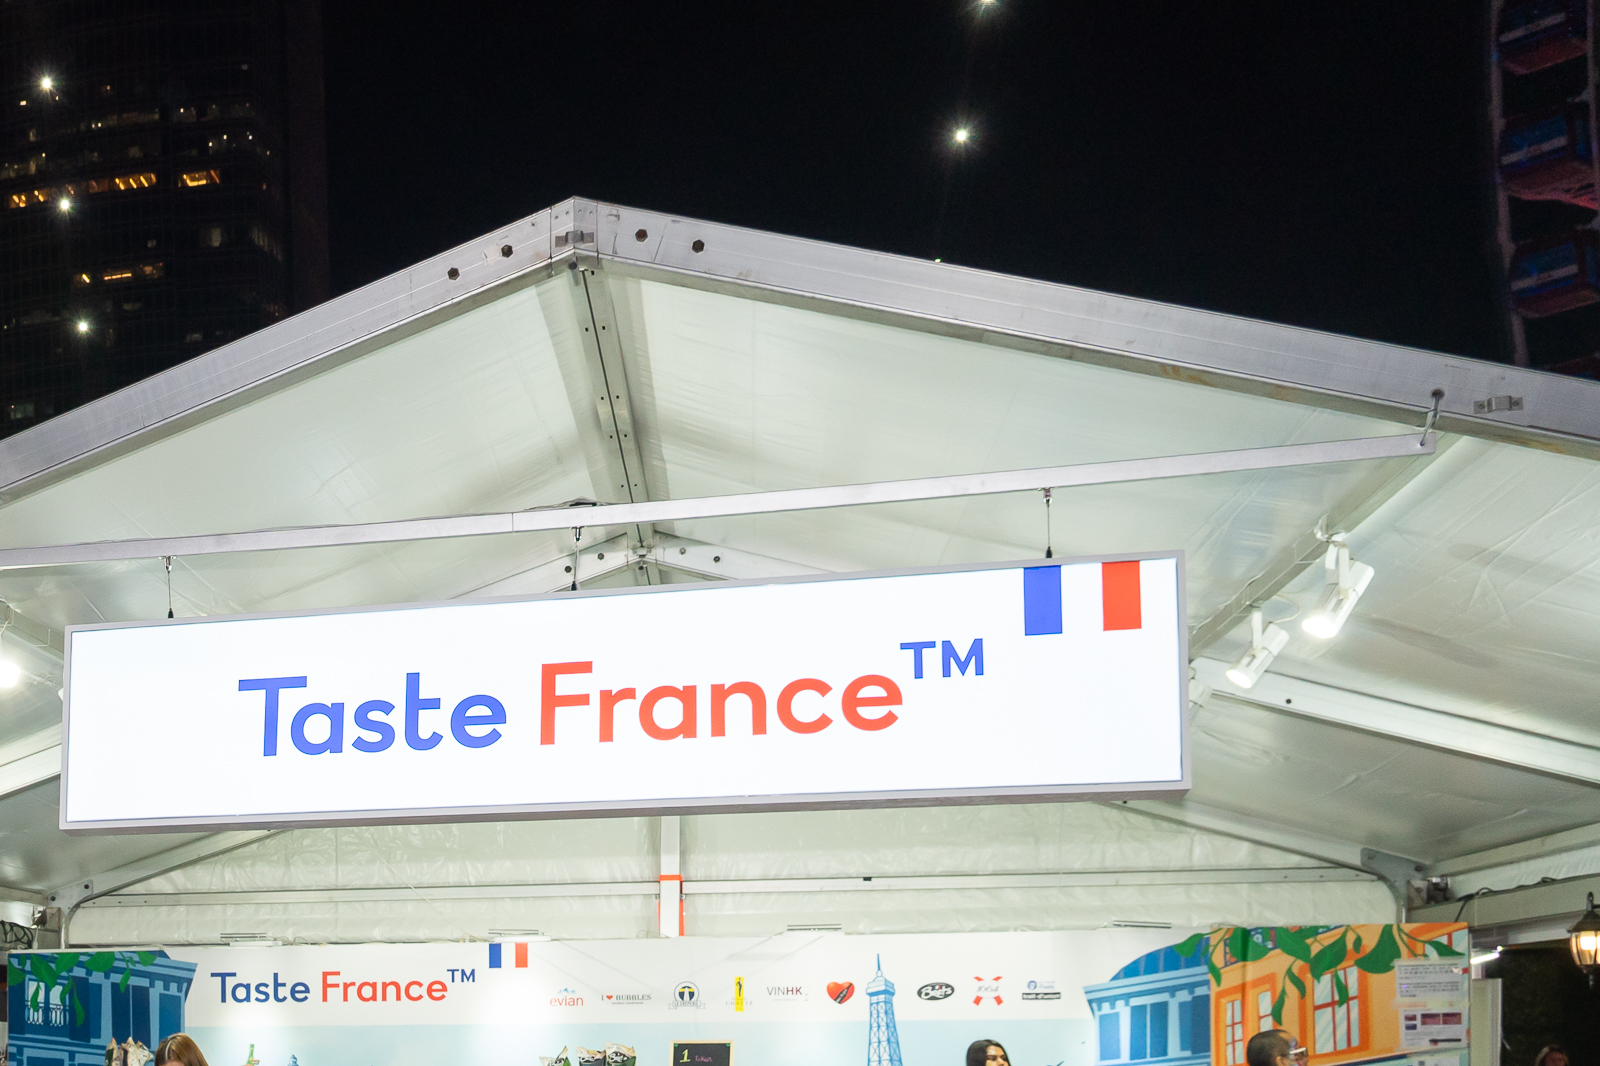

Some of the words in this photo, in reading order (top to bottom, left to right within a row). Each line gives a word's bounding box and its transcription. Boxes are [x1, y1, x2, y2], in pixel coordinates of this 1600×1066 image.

[237, 672, 507, 757] Taste
[210, 971, 311, 1003] Taste
[766, 986, 803, 996] VINHK
[549, 995, 584, 1007] evian
[679, 1049, 691, 1063] 1
